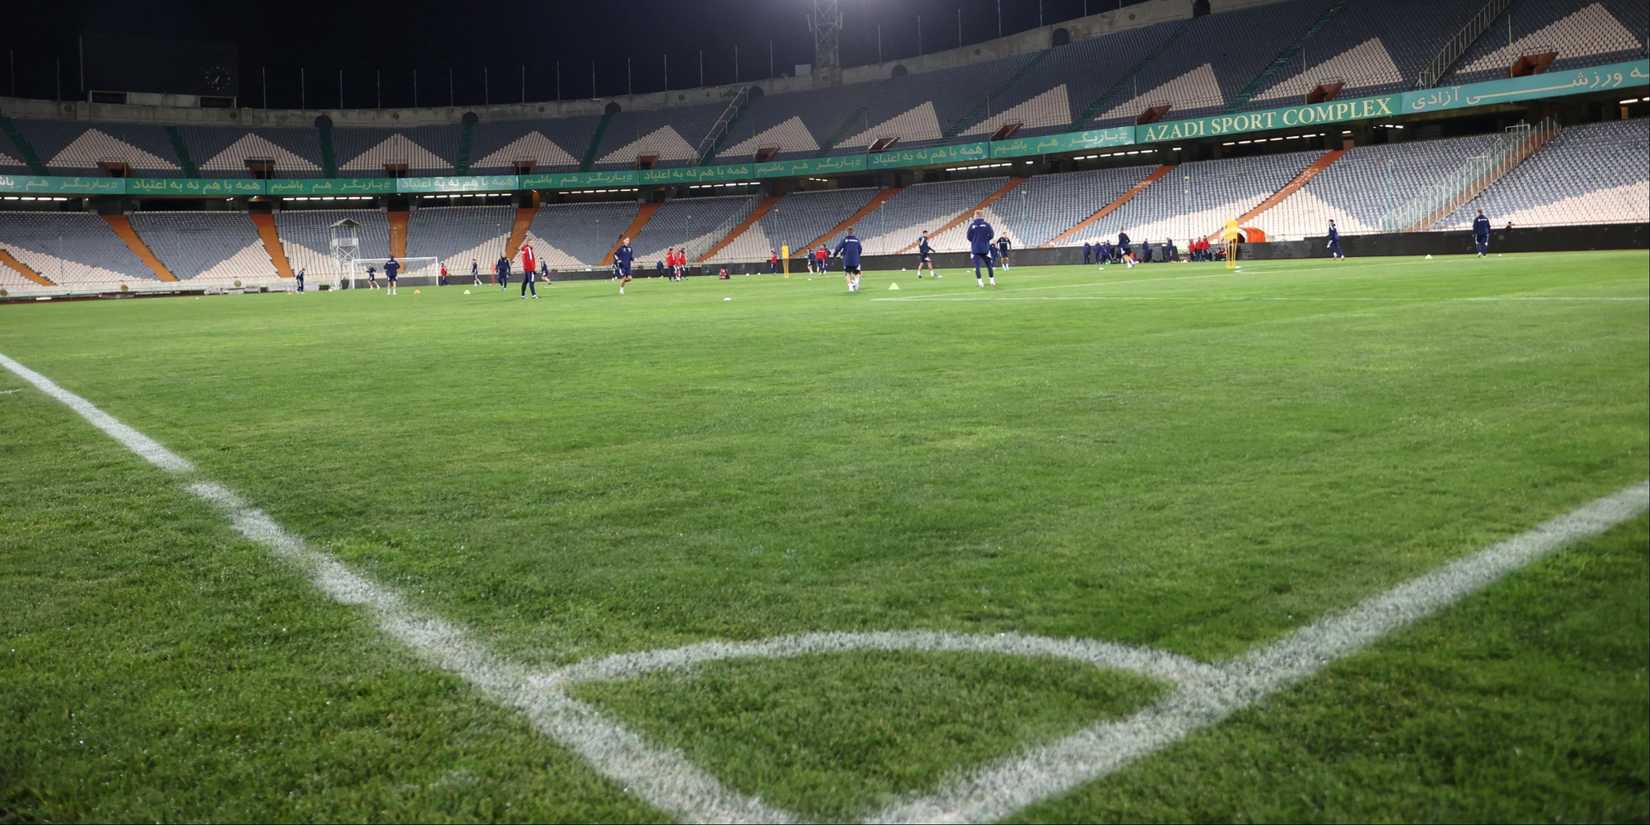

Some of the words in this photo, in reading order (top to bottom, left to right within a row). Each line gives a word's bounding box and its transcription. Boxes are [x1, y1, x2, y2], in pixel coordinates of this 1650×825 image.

[1411, 86, 1461, 110] آزادی
[1143, 122, 1205, 142] AZADI
[1211, 111, 1277, 135] SPORT
[1282, 97, 1393, 126] COMPLEX
